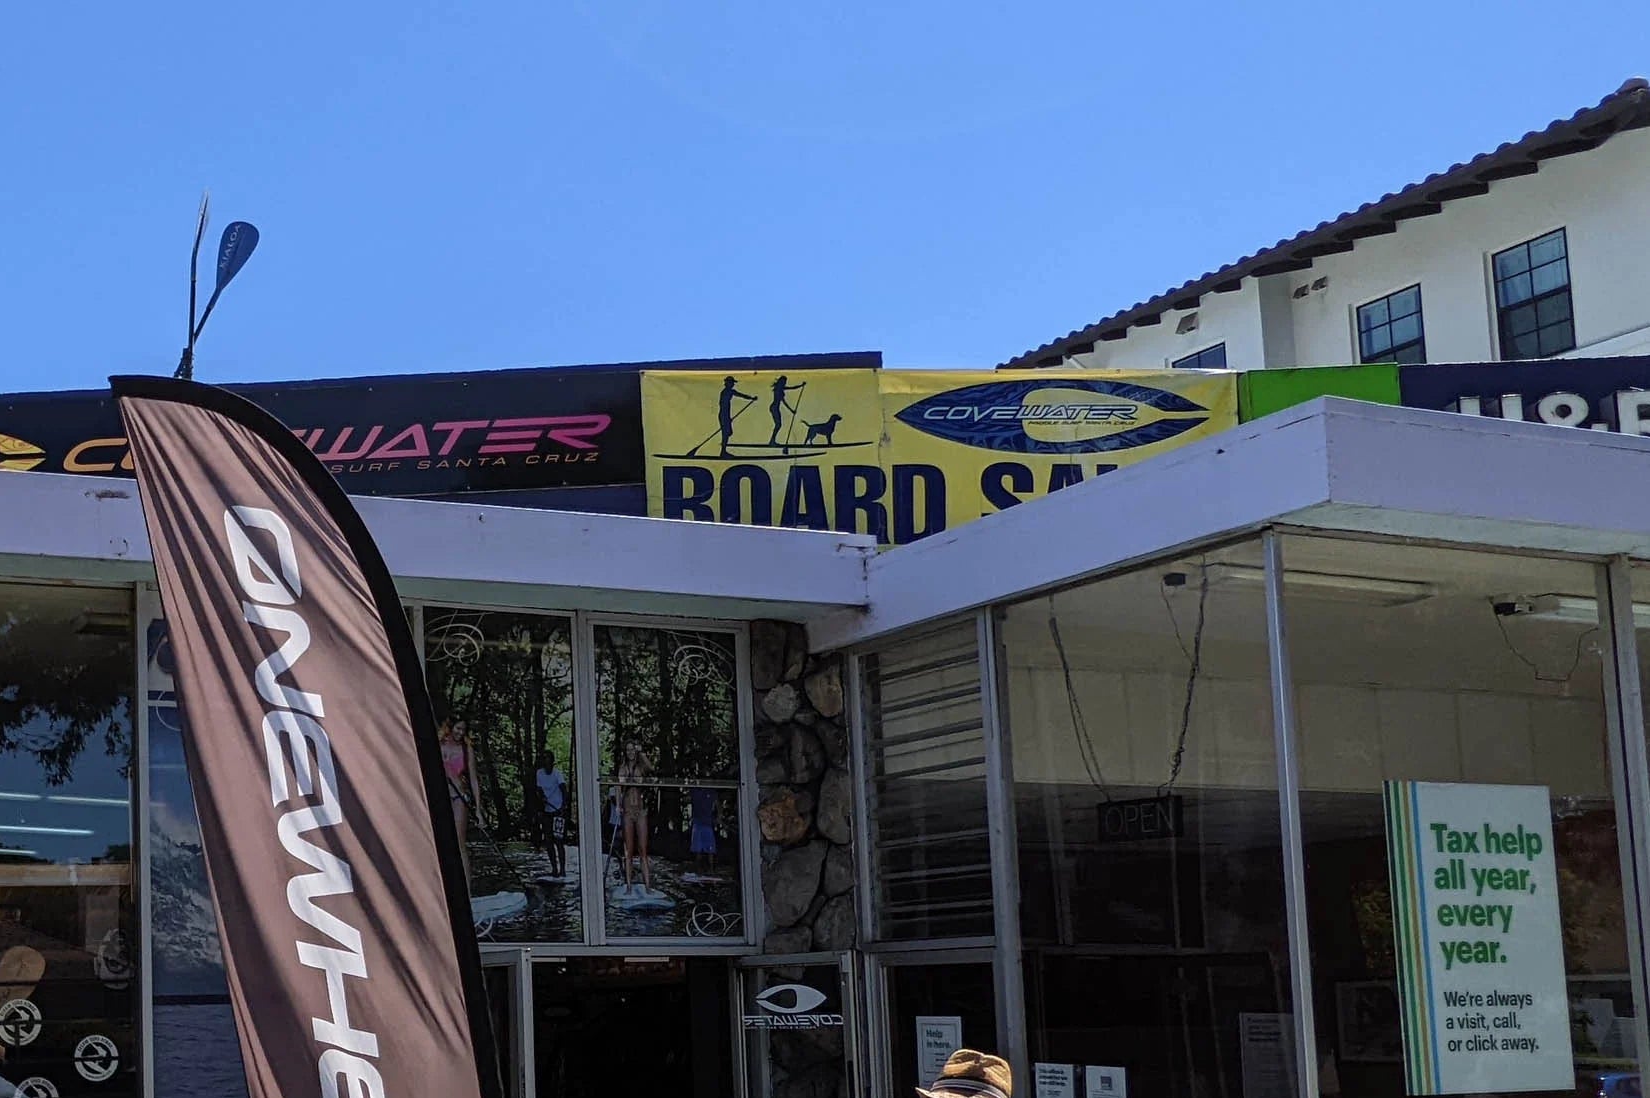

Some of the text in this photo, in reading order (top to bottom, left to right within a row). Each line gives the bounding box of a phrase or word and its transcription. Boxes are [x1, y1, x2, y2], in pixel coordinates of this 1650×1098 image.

[923, 405, 1138, 422] COVEWATER
[330, 452, 600, 474] SURF SANTA CRUZ
[662, 464, 947, 545] BOARD
[1105, 802, 1174, 835] OPEN
[1430, 823, 1543, 861] Tax help
[1434, 860, 1537, 896] all year,
[1437, 903, 1513, 933] every
[1439, 940, 1507, 970] year.
[1444, 991, 1533, 1009] We're always
[1445, 1012, 1521, 1031] a visit, call,
[1447, 1036, 1540, 1053] or click away.
